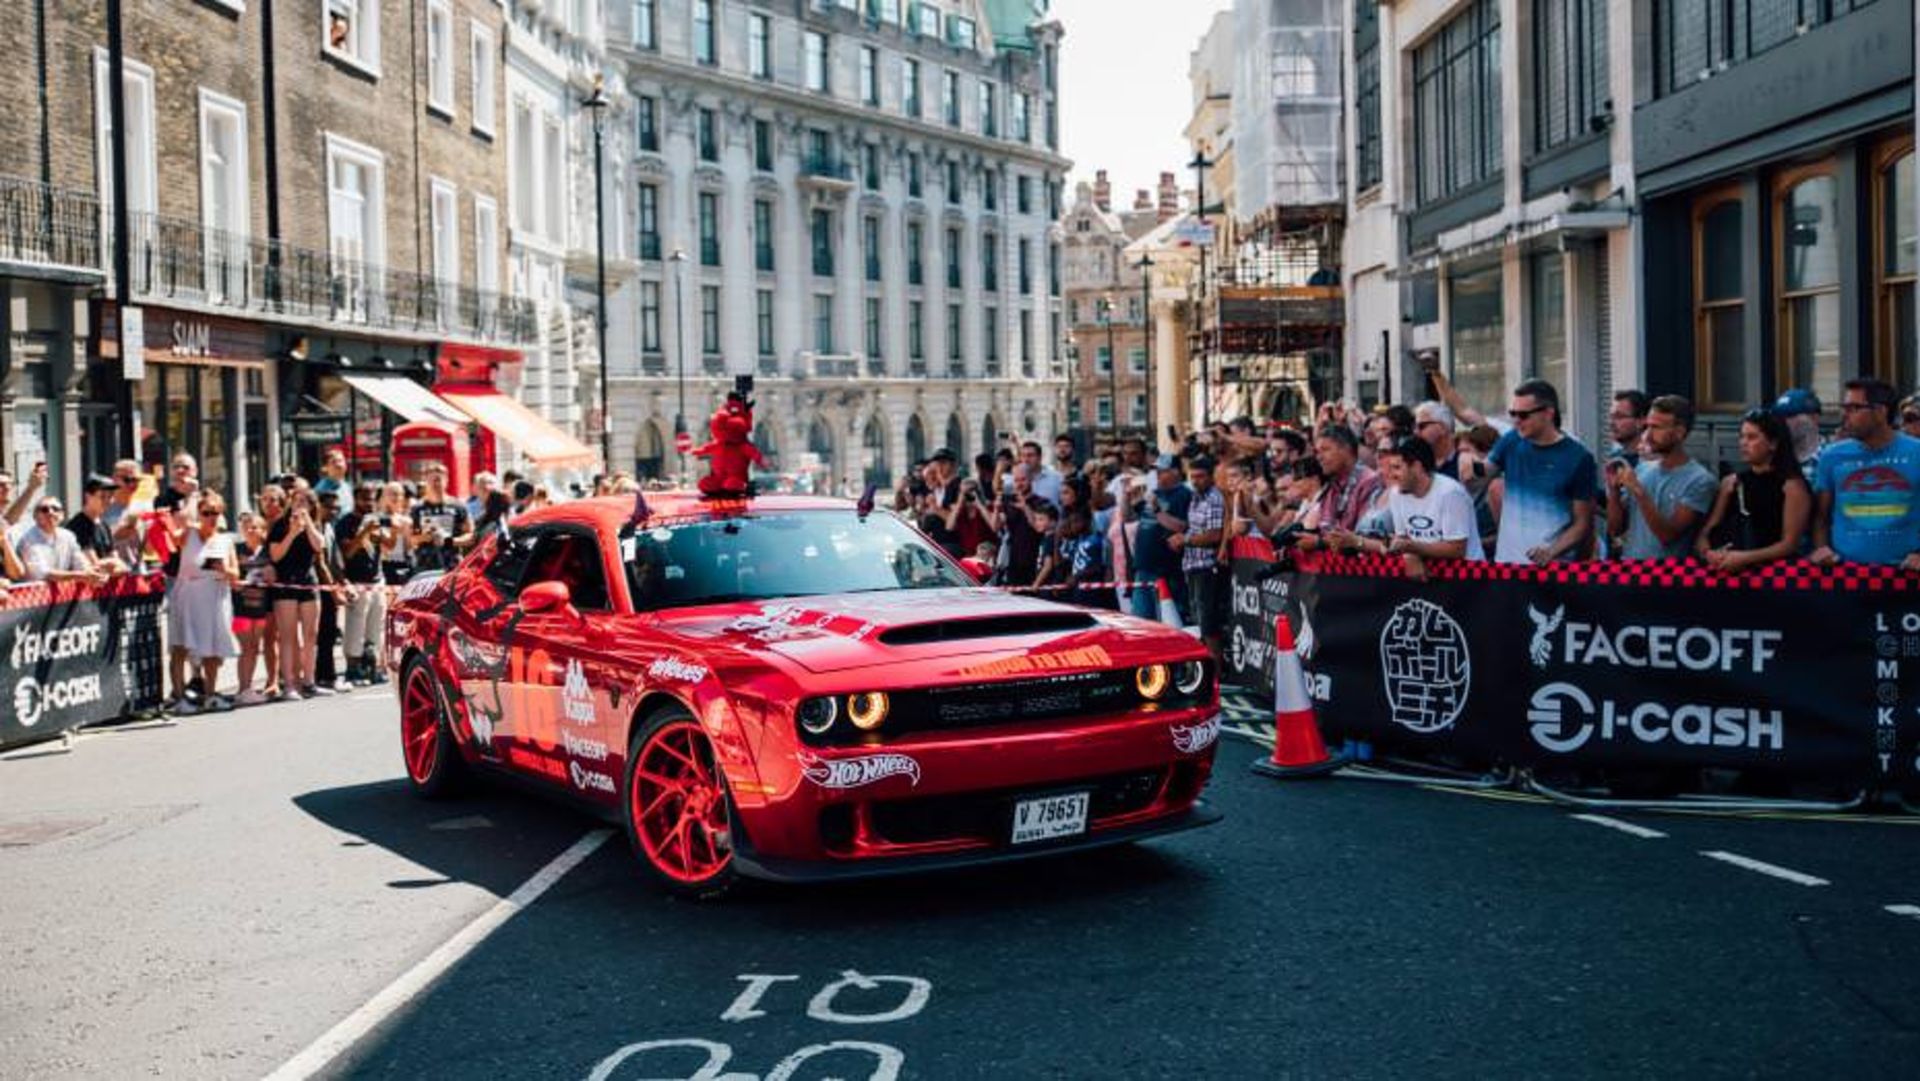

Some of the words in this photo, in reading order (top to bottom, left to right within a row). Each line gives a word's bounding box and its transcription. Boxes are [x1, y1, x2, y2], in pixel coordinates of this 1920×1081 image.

[172, 320, 211, 356] SIAM
[23, 623, 101, 665] FACEOFF
[1564, 622, 1783, 673] FACEOFF
[1020, 803, 1030, 825] V
